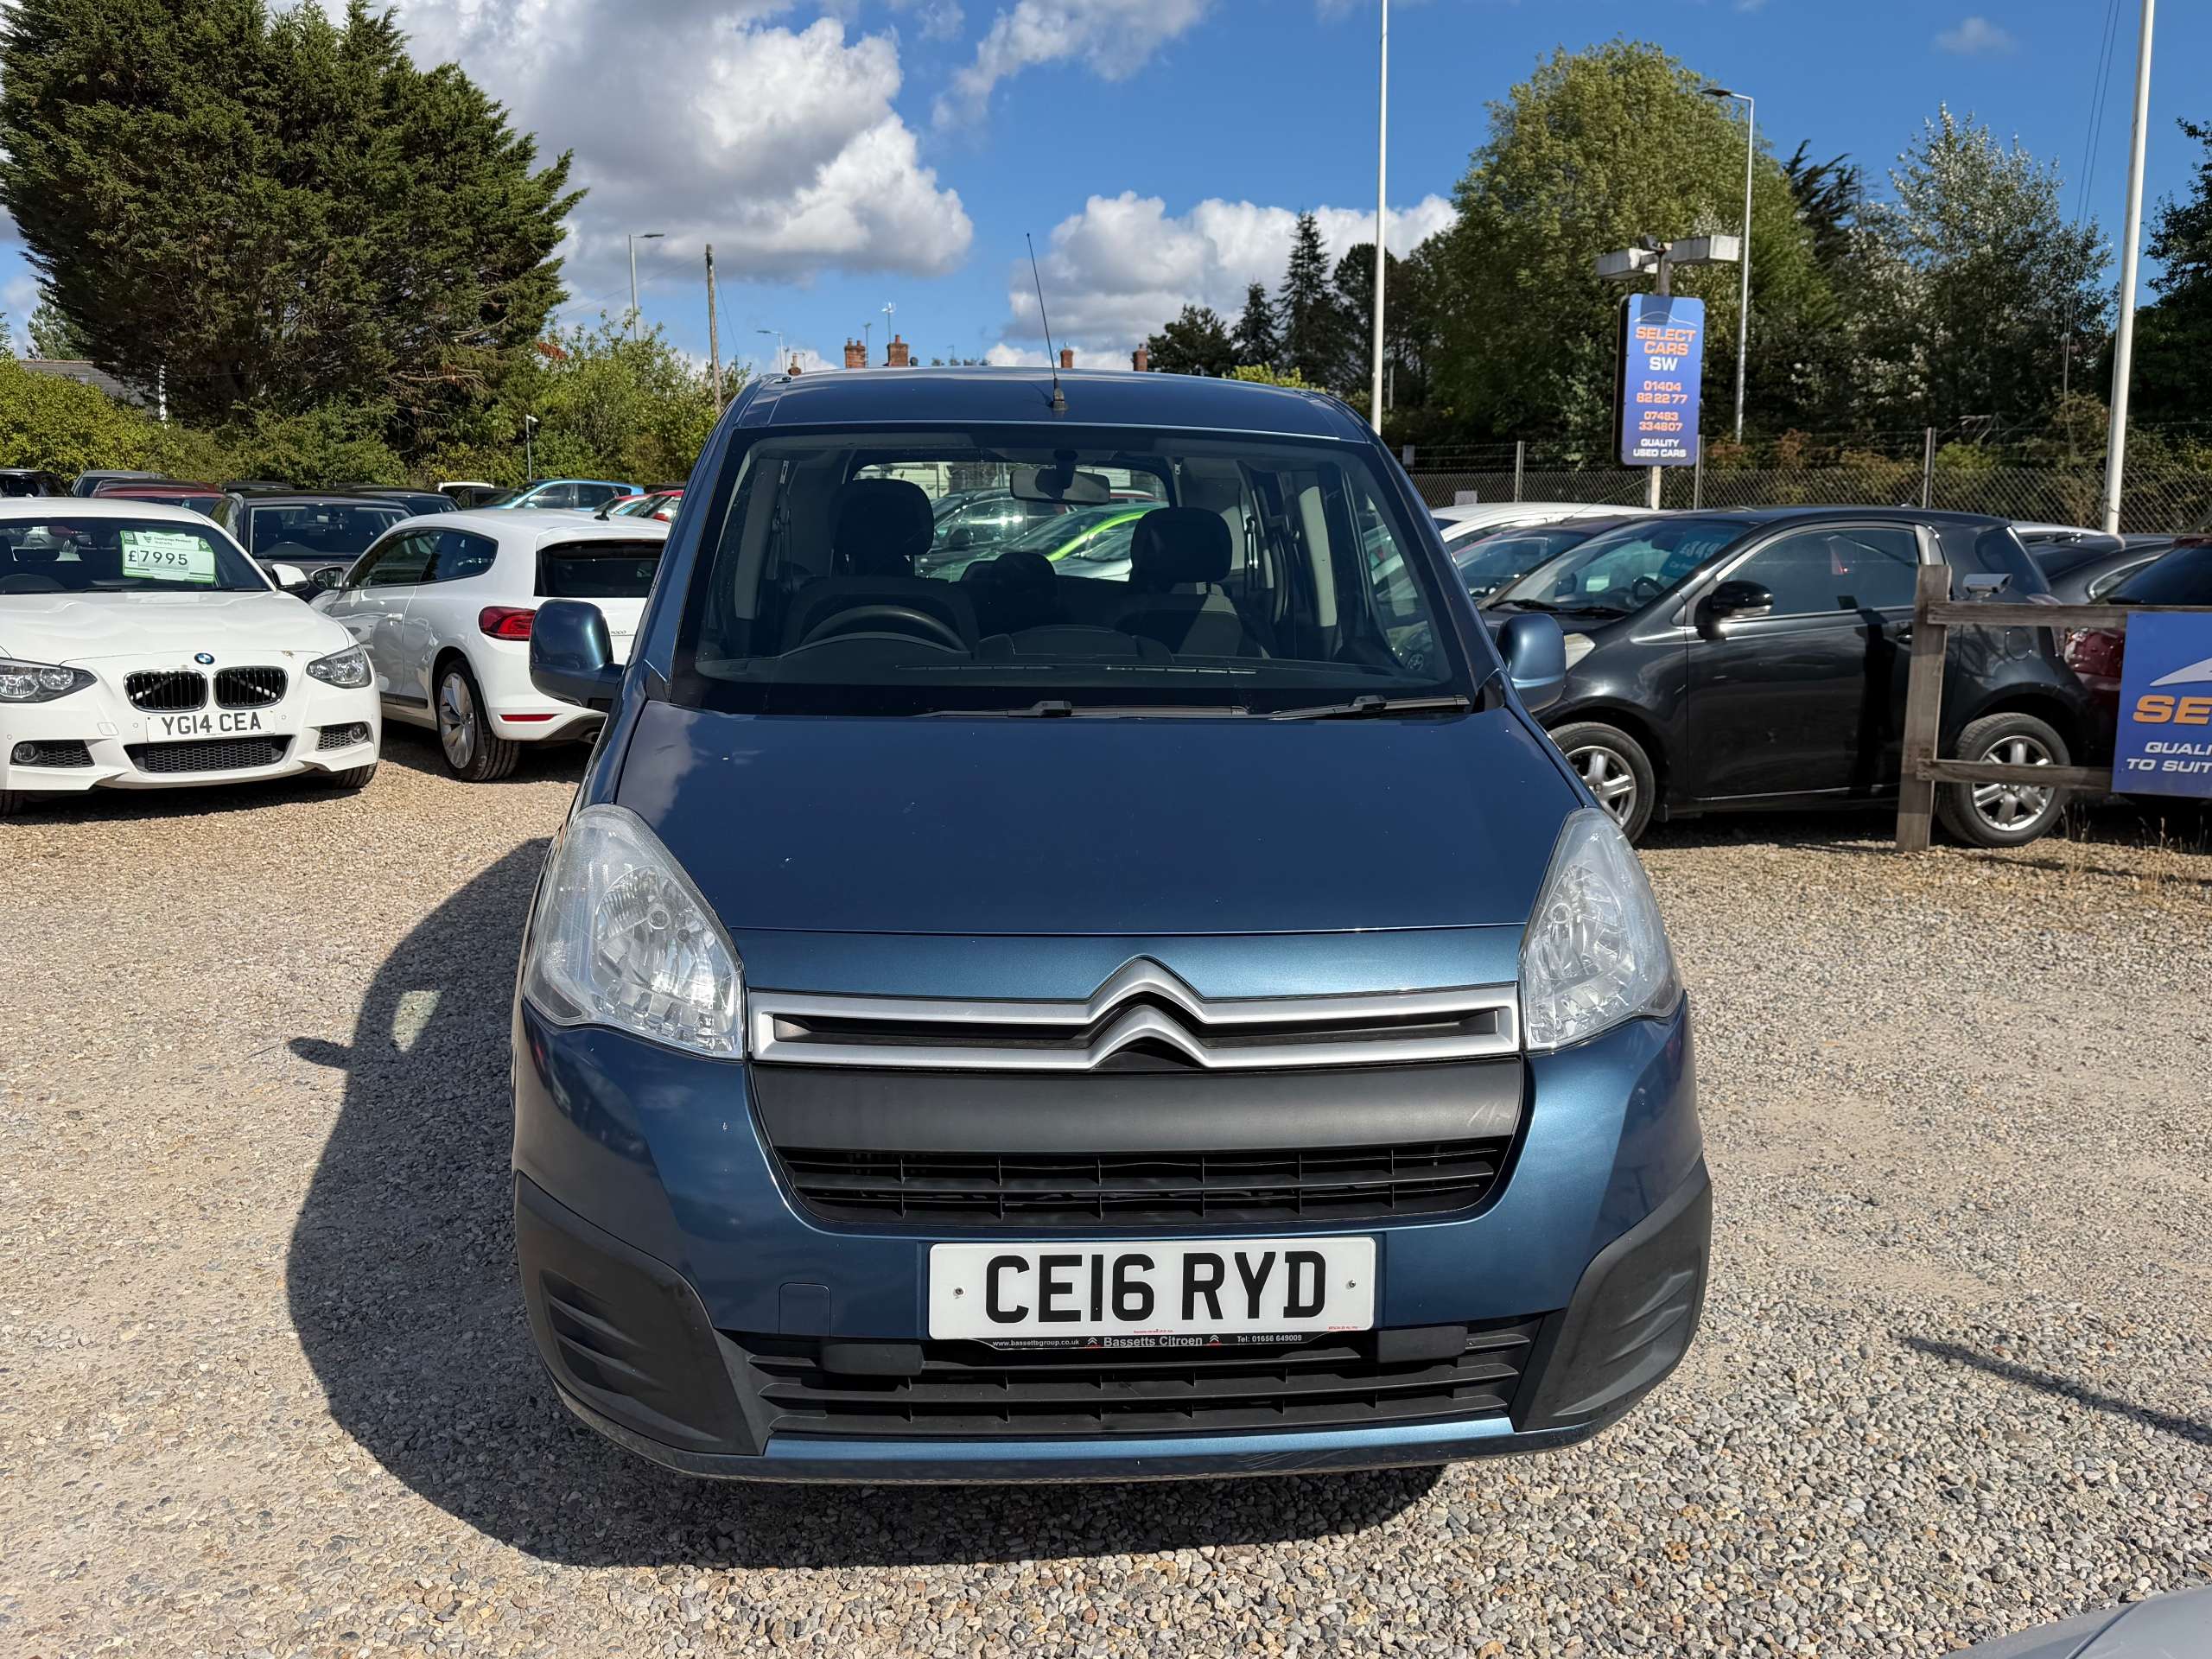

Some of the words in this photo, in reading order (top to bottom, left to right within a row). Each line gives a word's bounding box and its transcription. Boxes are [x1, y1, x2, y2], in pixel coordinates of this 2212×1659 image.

[1635, 326, 1696, 342] SELECT
[1643, 340, 1688, 356] CARS
[1649, 356, 1678, 372] SW
[1640, 438, 1680, 448] QUALITY
[1632, 448, 1659, 457] USED
[1660, 448, 1687, 458] CARS
[128, 550, 188, 566] £7995
[2133, 694, 2212, 725] SE
[162, 714, 213, 736] YG14
[219, 711, 262, 732] CEA
[2126, 758, 2157, 771] TO
[985, 1253, 1155, 1324] CE16
[1181, 1250, 1326, 1320] RYD
[1103, 1336, 1156, 1347] Bassetts
[1159, 1336, 1203, 1346] Citroen
